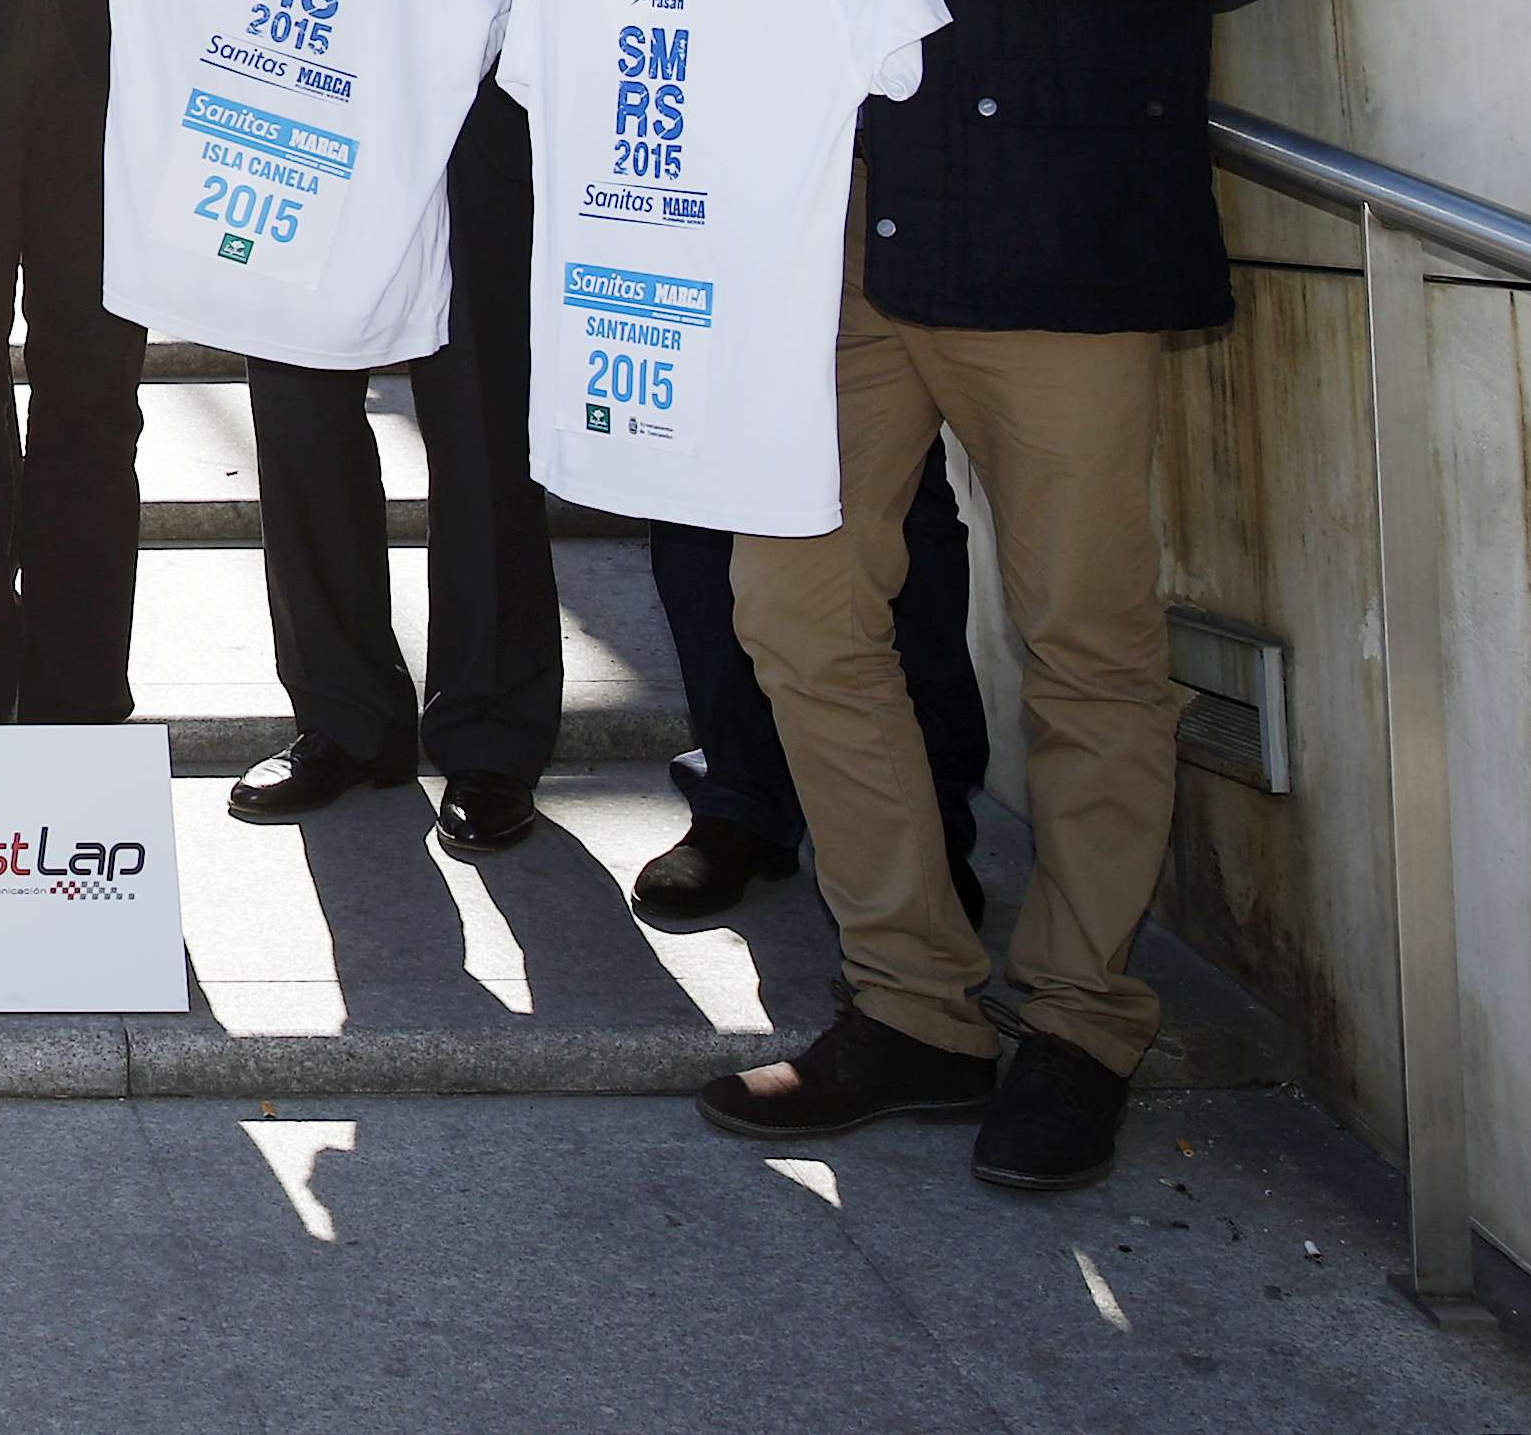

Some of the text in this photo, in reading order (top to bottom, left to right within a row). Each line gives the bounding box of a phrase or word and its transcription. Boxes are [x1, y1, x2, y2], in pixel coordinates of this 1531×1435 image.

[246, 3, 333, 56] 2015
[618, 25, 689, 82] SM
[206, 34, 352, 98] Sanitas MARCA
[190, 94, 352, 164] Sanitas MARCA
[615, 80, 685, 141] RS
[201, 140, 242, 171] ISLA
[247, 155, 319, 195] CANELA
[612, 139, 682, 180] 2015
[193, 174, 304, 244] 2015
[583, 183, 706, 219] Sanitas MARCA
[568, 266, 707, 311] Sanitas MARCA
[585, 315, 682, 351] SANTANDER
[586, 349, 674, 410] 2015
